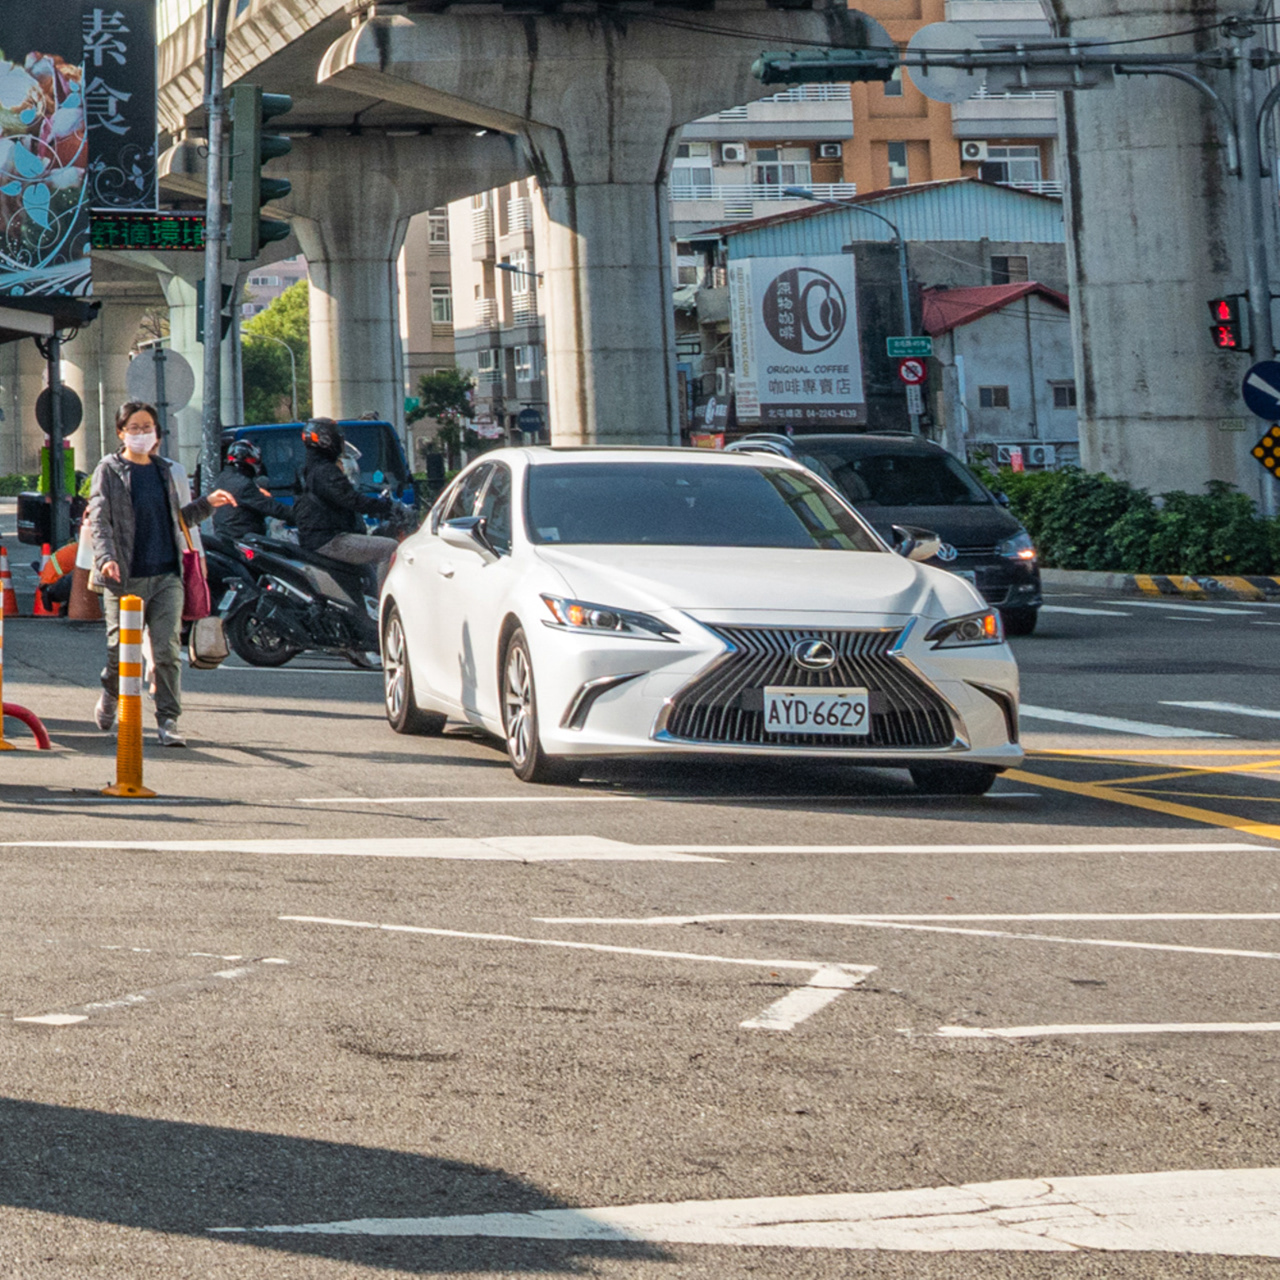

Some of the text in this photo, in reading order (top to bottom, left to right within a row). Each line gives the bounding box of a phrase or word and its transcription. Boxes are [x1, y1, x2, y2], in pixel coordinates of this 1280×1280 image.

[766, 364, 850, 375] ORIGINAL COFFEE
[768, 377, 852, 396] 咖啡專賣店
